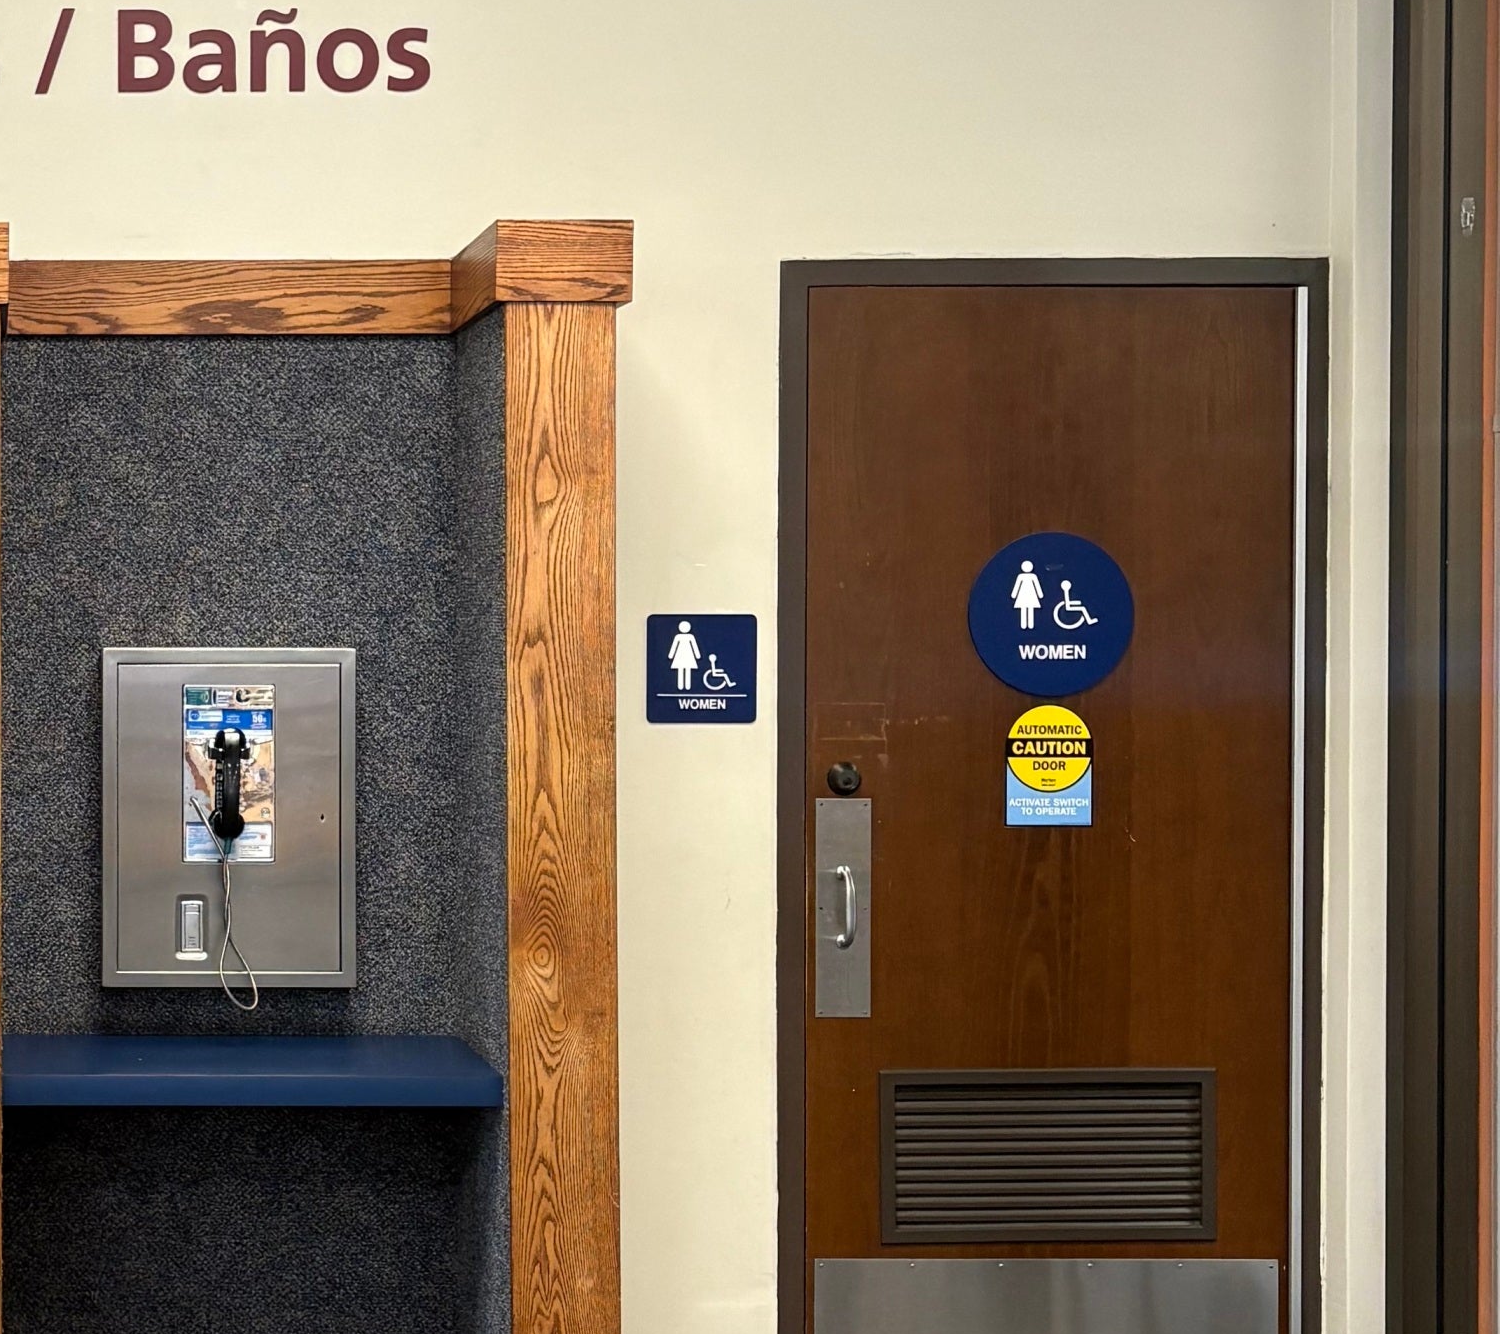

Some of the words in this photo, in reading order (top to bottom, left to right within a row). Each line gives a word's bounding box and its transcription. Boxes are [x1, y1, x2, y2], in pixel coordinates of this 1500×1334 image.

[35, 8, 75, 94] /
[118, 7, 431, 93] Baños
[1019, 644, 1087, 660] WOMEN
[678, 699, 727, 710] WOMEN
[1017, 725, 1082, 735] AUTOMATIC
[1012, 741, 1086, 755] CAUTION
[1033, 761, 1066, 770] DOOR
[1009, 798, 1051, 807] ACTIVATE
[1053, 798, 1089, 807] SWITCH
[1021, 807, 1033, 815] TO
[1035, 807, 1077, 816] OPERATE
